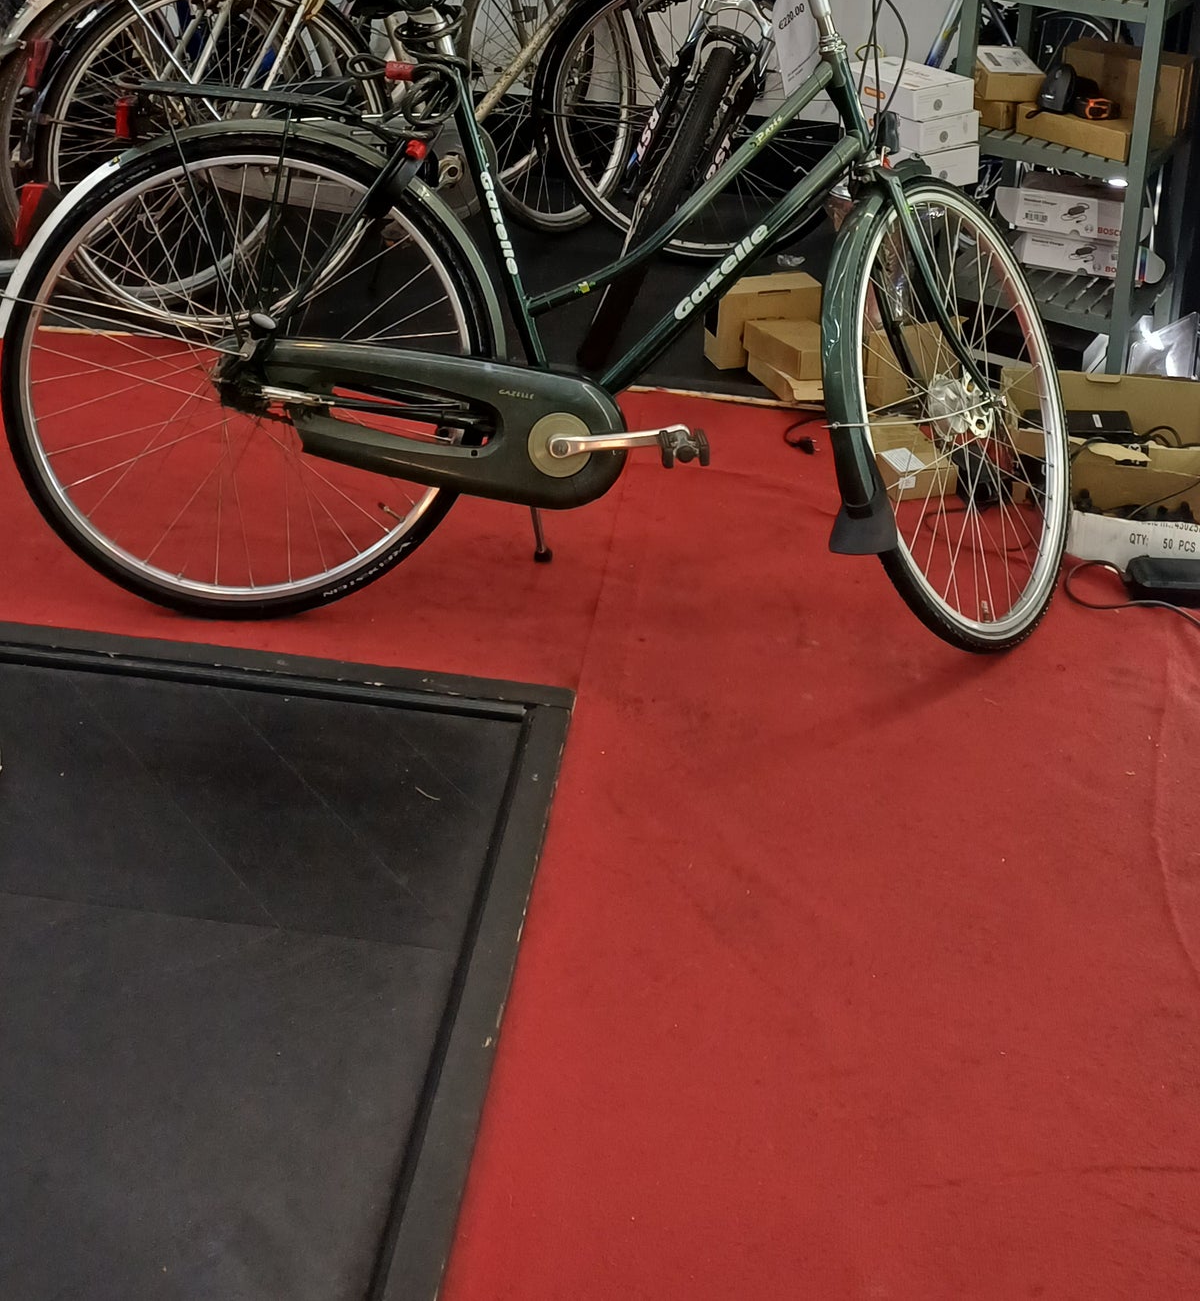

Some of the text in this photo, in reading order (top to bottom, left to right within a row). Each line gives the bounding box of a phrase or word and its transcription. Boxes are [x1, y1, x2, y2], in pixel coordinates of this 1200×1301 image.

[480, 171, 518, 275] Gazelle
[1097, 226, 1121, 237] BOSC
[674, 224, 768, 320] Gazelle
[1162, 538, 1173, 550] 50
[1178, 539, 1196, 553] PCS
